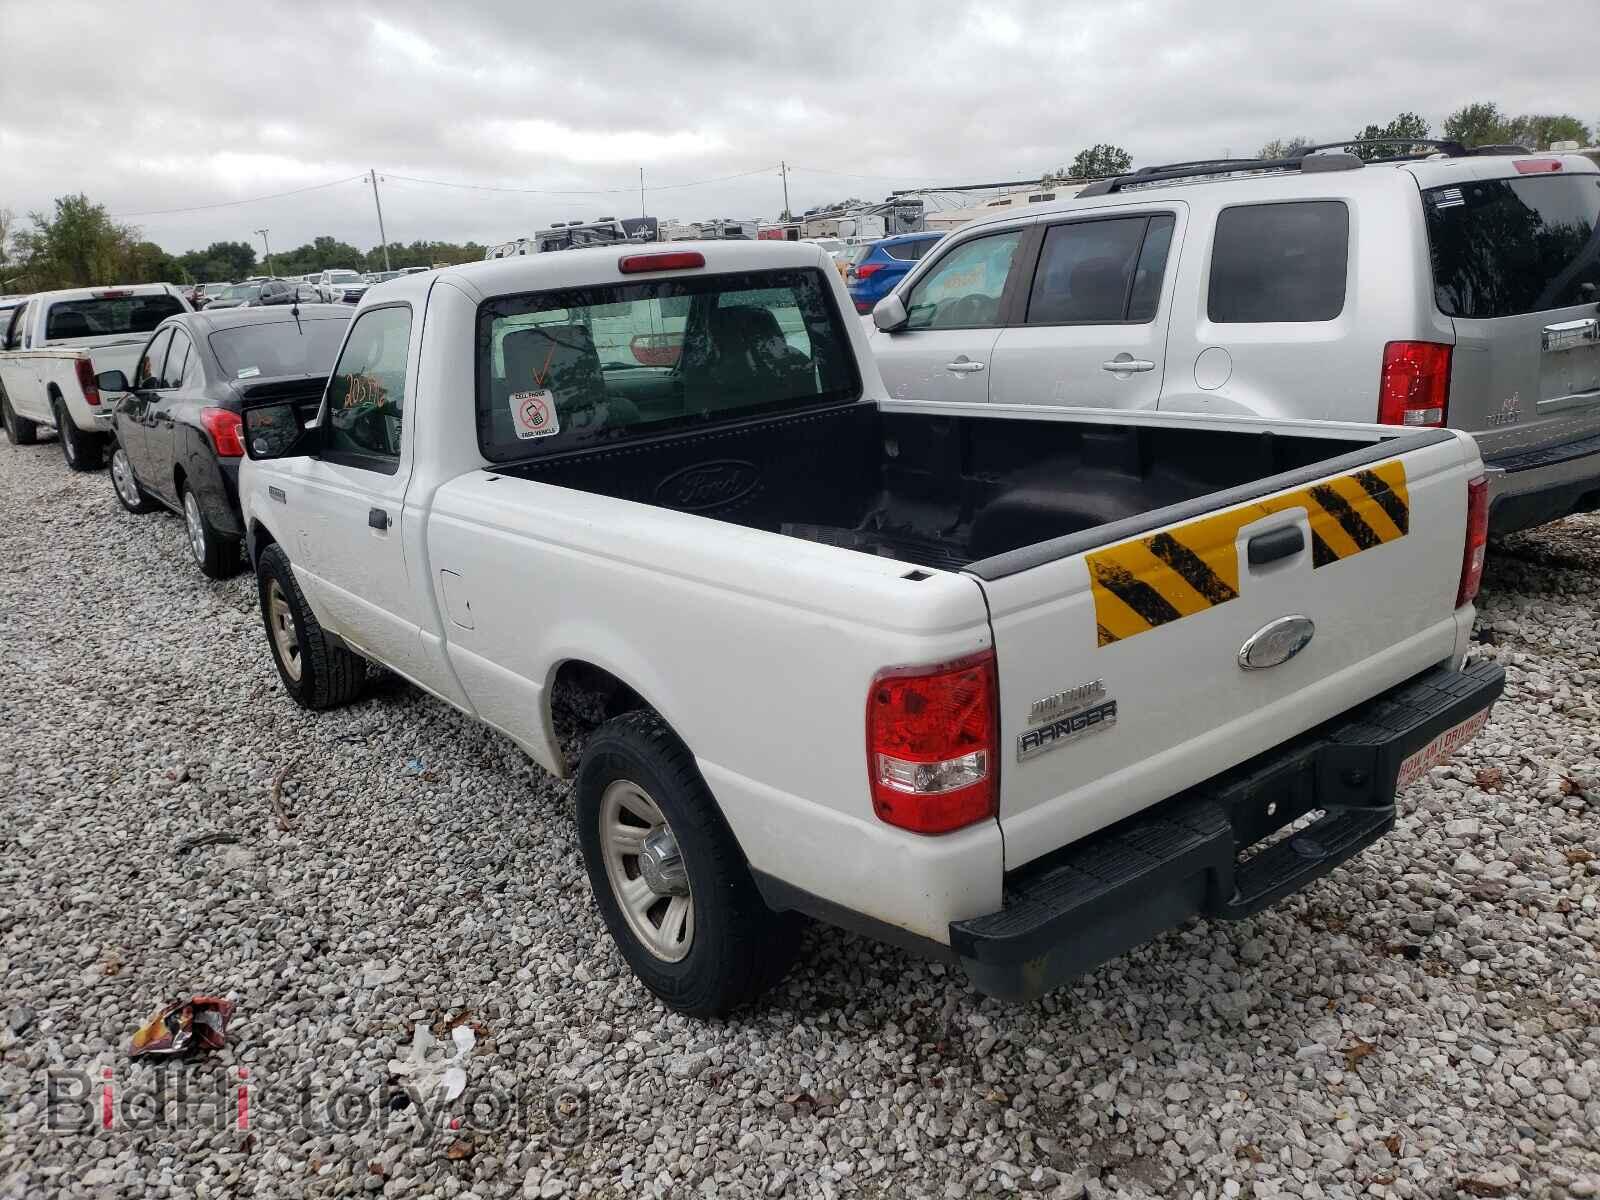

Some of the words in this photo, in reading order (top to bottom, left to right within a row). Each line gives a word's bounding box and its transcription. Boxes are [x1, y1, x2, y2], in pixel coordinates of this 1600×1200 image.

[1020, 699, 1118, 753] RANGER
[1401, 755, 1423, 777] HOW
[1424, 743, 1438, 758] AM
